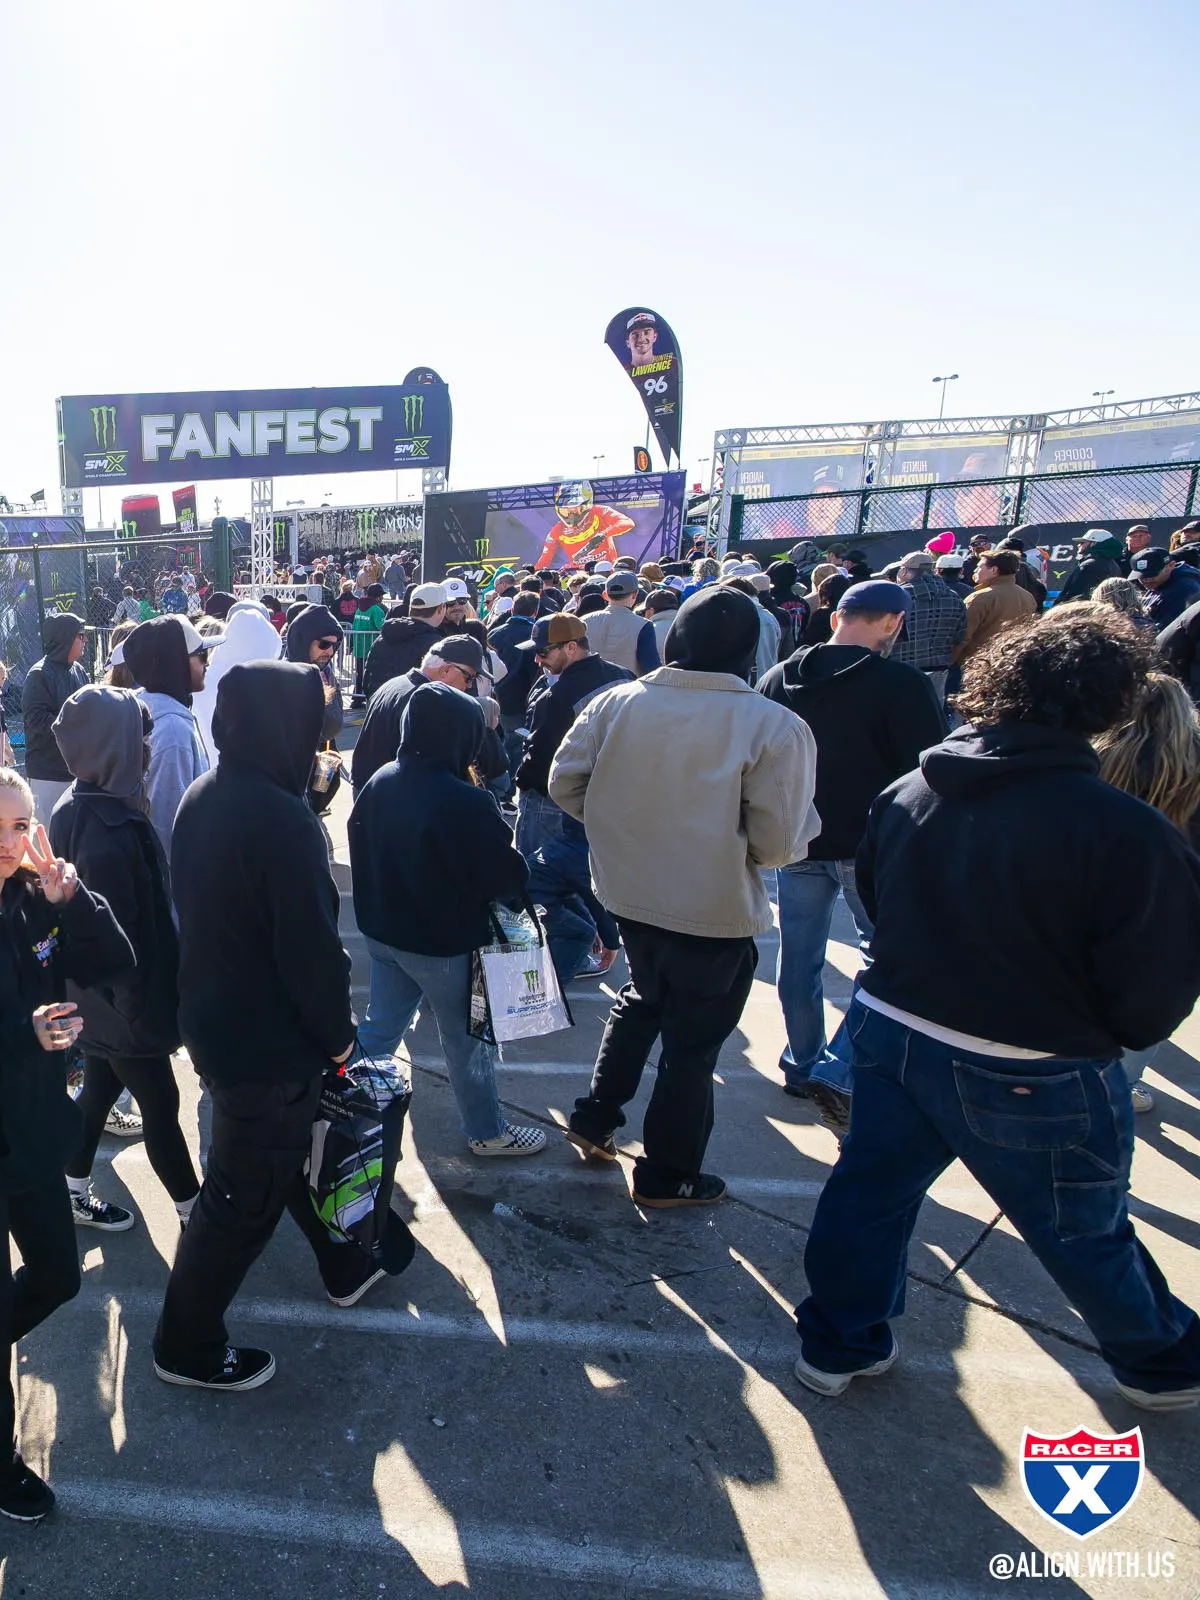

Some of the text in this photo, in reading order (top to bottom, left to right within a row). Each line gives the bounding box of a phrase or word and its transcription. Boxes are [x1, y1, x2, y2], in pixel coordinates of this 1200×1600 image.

[631, 360, 673, 377] LAWRENCE
[644, 376, 668, 396] 96
[141, 405, 383, 462] FANFEST
[394, 439, 430, 456] SMX
[85, 455, 127, 472] SMX
[385, 515, 423, 531] MONS
[464, 562, 518, 588] MX
